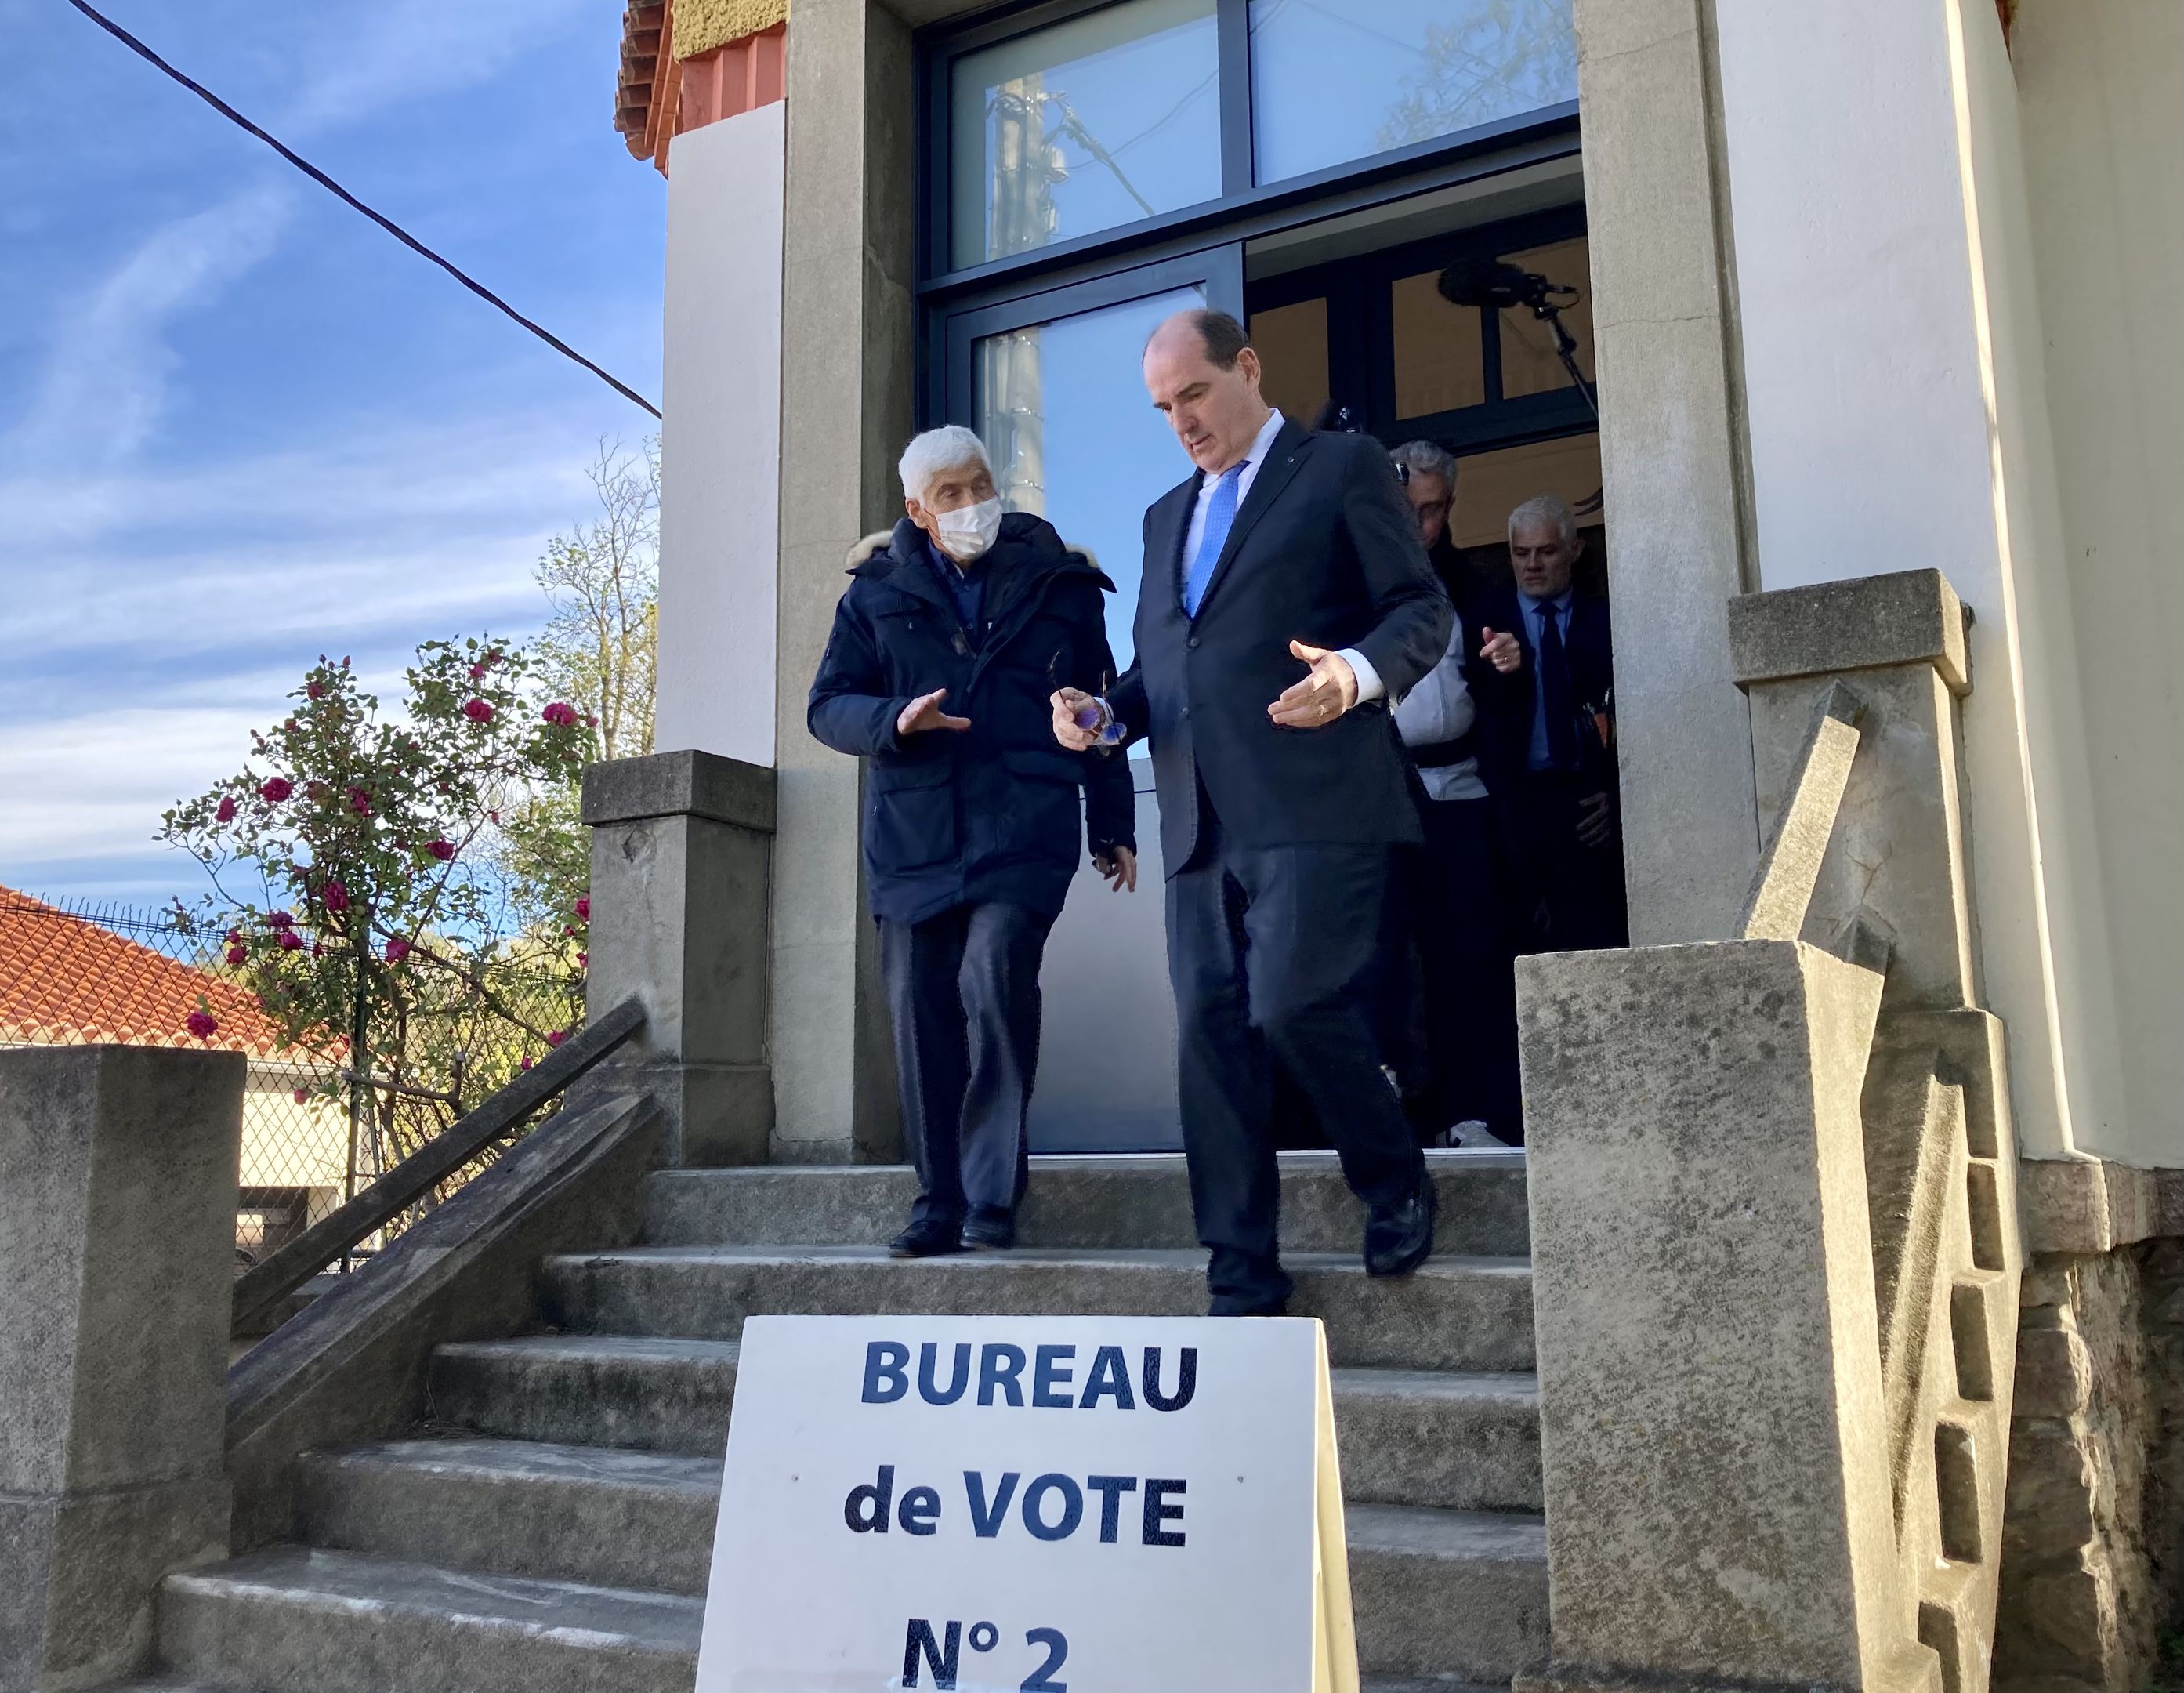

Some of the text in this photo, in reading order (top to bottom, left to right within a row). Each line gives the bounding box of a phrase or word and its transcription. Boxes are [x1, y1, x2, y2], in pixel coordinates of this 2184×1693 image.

[861, 1341, 1198, 1412] BUREAU
[844, 1465, 1187, 1547] de VOTE
[1020, 1627, 1069, 1693] 2
